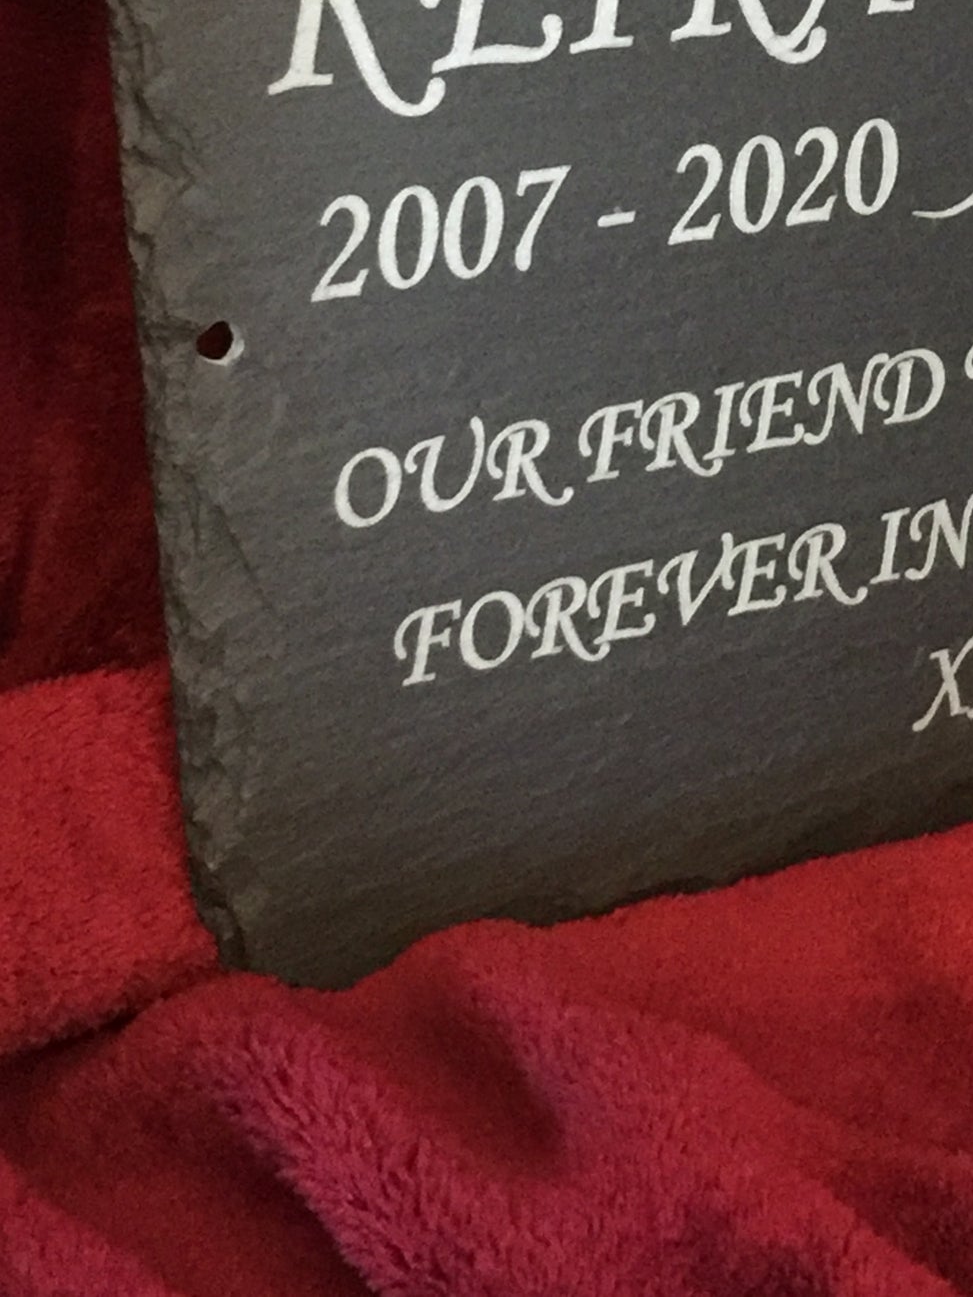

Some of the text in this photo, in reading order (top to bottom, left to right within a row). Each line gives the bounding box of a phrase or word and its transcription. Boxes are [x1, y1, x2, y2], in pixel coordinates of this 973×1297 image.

[309, 118, 900, 304] 2007 - 2020
[332, 415, 575, 530] OUR
[577, 347, 946, 484] FRIEND
[392, 522, 869, 687] FOREVER
